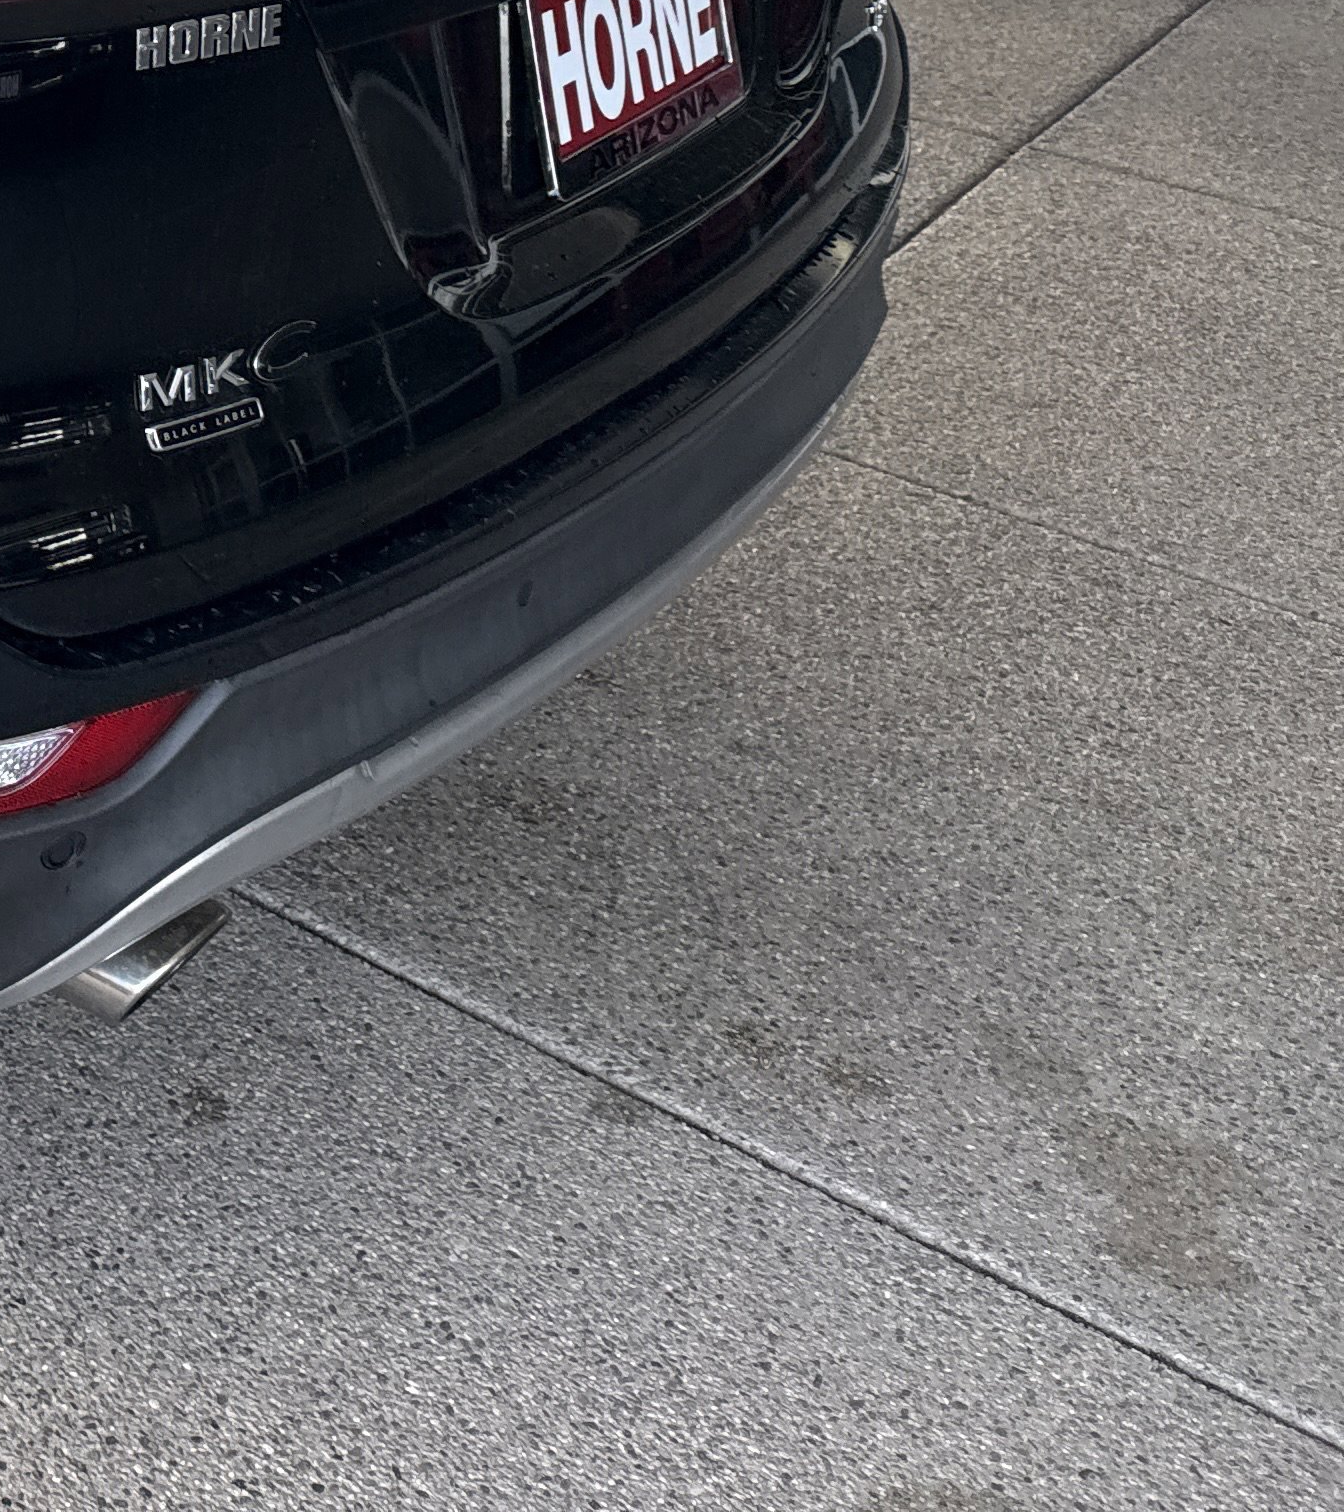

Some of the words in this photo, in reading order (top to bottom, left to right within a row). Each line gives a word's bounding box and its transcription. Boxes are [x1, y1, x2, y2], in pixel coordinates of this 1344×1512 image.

[136, 4, 282, 71] HORNE
[589, 83, 720, 178] ARIZONA
[138, 319, 317, 412] MKC
[163, 421, 207, 442] BLACK
[215, 406, 256, 427] LABEL
